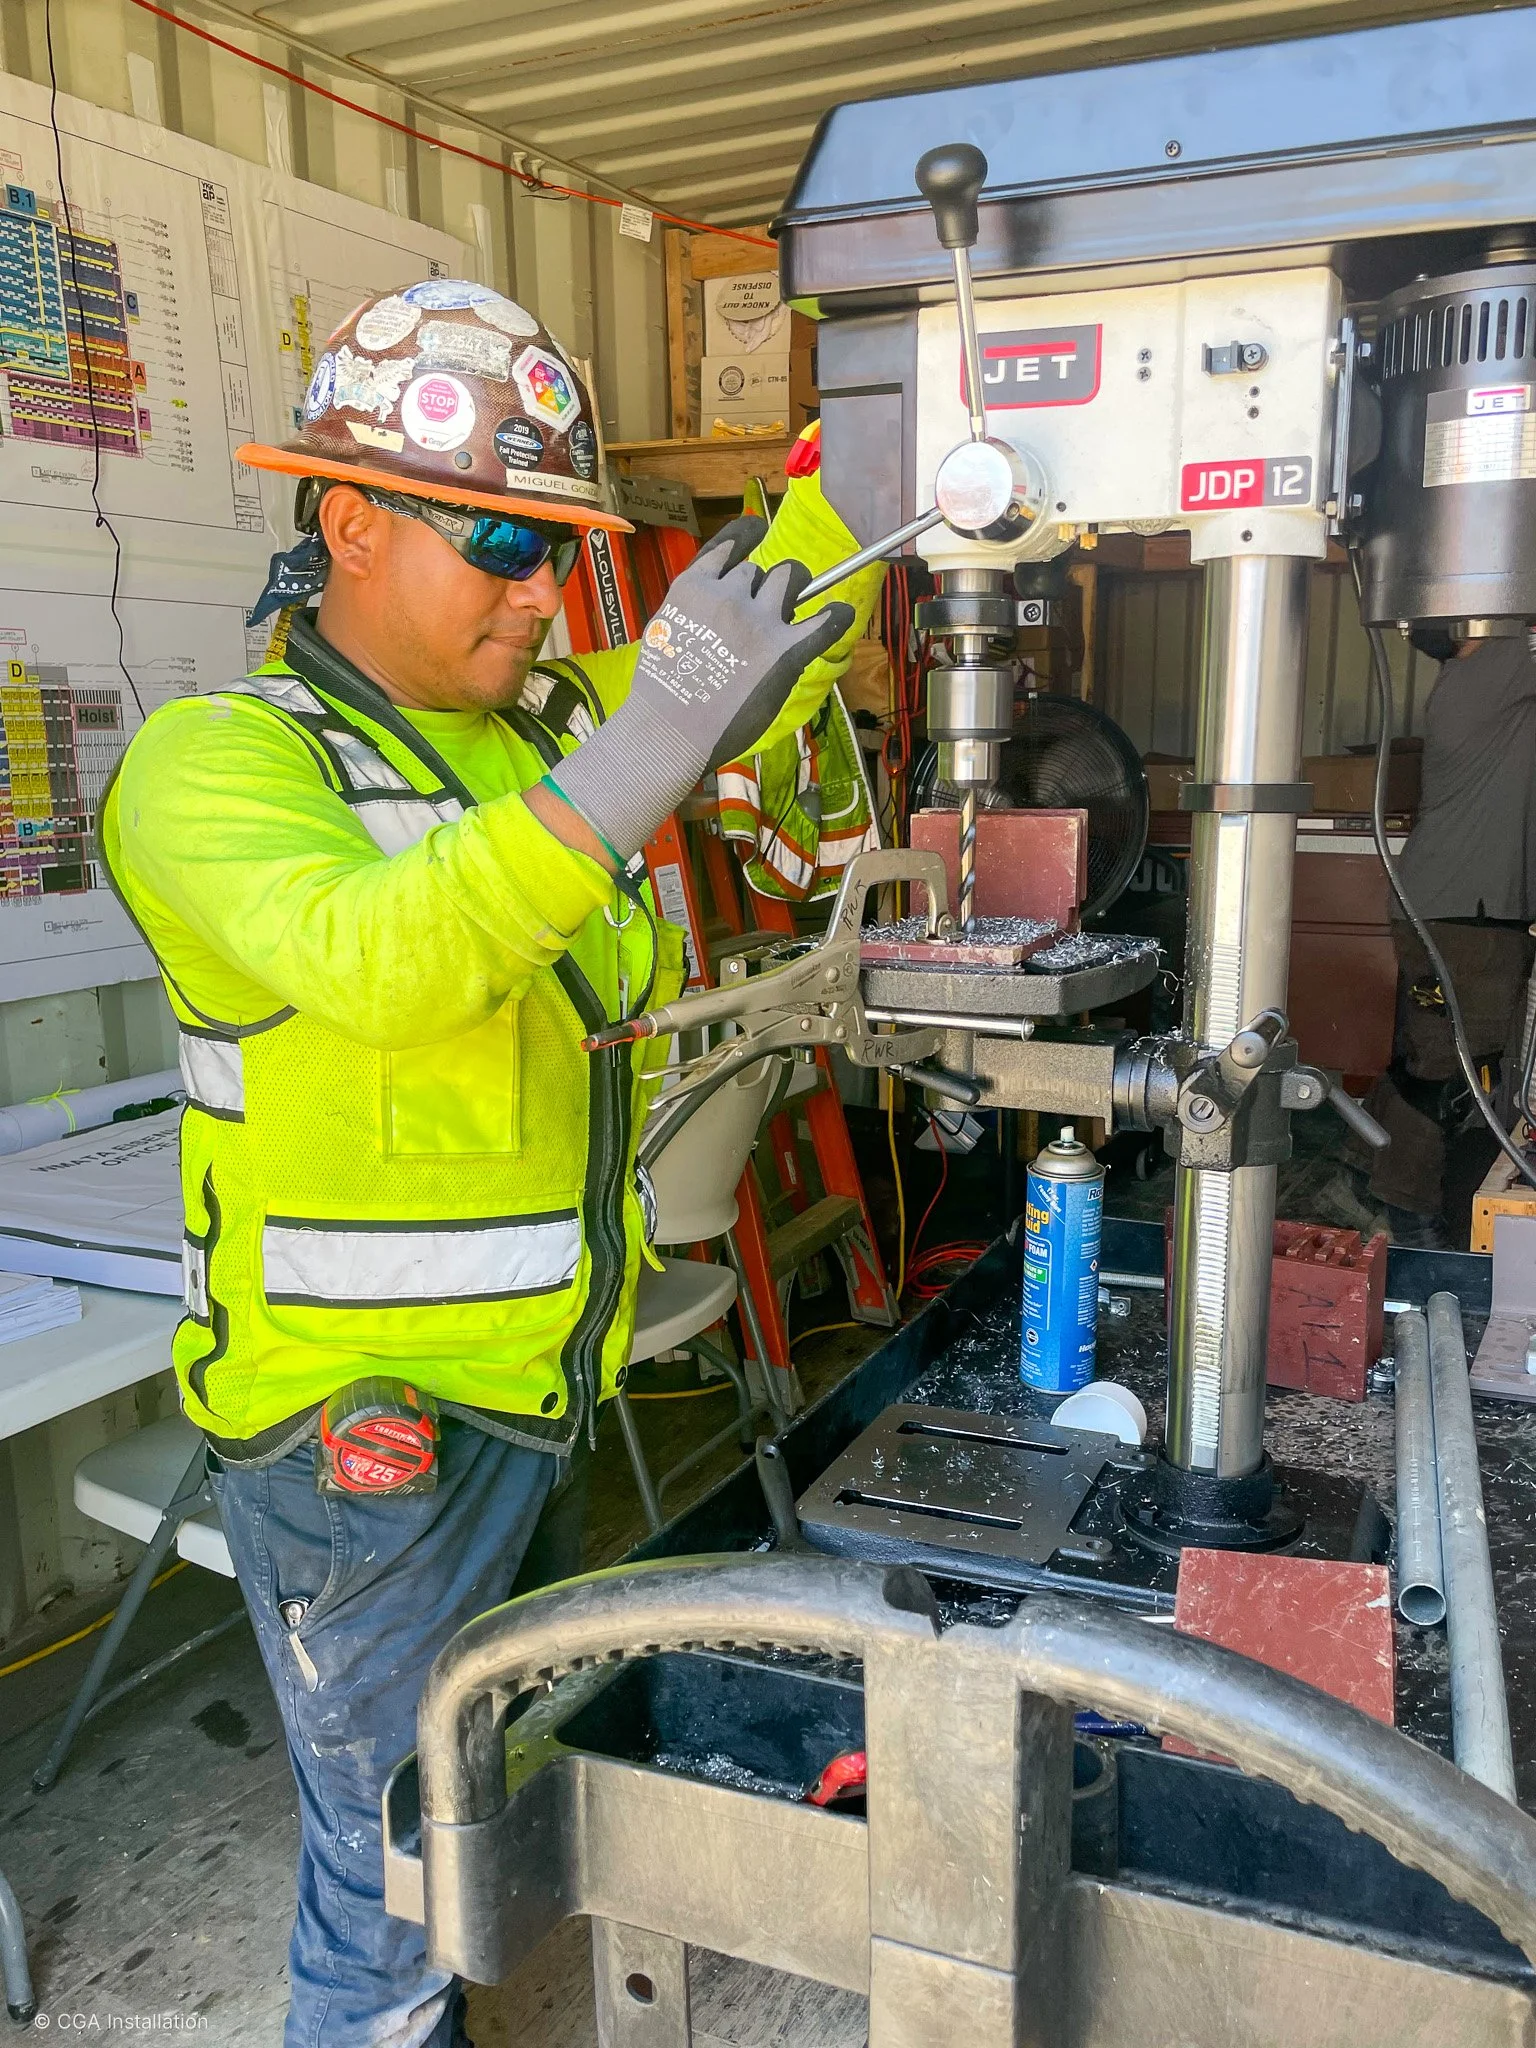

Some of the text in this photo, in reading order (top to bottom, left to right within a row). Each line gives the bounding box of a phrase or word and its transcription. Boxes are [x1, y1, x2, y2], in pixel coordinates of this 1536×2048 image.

[9, 188, 32, 208] B.1
[732, 281, 772, 291] DISPENSE
[126, 294, 137, 310] C
[743, 292, 754, 300] TO
[742, 301, 770, 309] KNOCK
[282, 333, 291, 346] D
[134, 364, 145, 380] A
[983, 354, 1077, 385] JET
[421, 392, 455, 408] STOP
[1474, 395, 1526, 410] JET
[139, 410, 148, 424] F
[513, 423, 530, 435] 2019
[506, 434, 537, 447] WERNER
[499, 446, 538, 462] Fall Protection
[508, 456, 529, 468] Trained
[514, 475, 568, 491] MIGUEL
[1188, 465, 1304, 503] JDP 12
[631, 495, 687, 514] LOUISVILLE
[11, 663, 23, 678] D
[78, 708, 116, 723] Hoist
[23, 821, 34, 836] B
[862, 1039, 895, 1059] RWR
[101, 1141, 173, 1167] OFFICE
[29, 1151, 113, 1173] WMATA
[1028, 1243, 1048, 1258] FOAM
